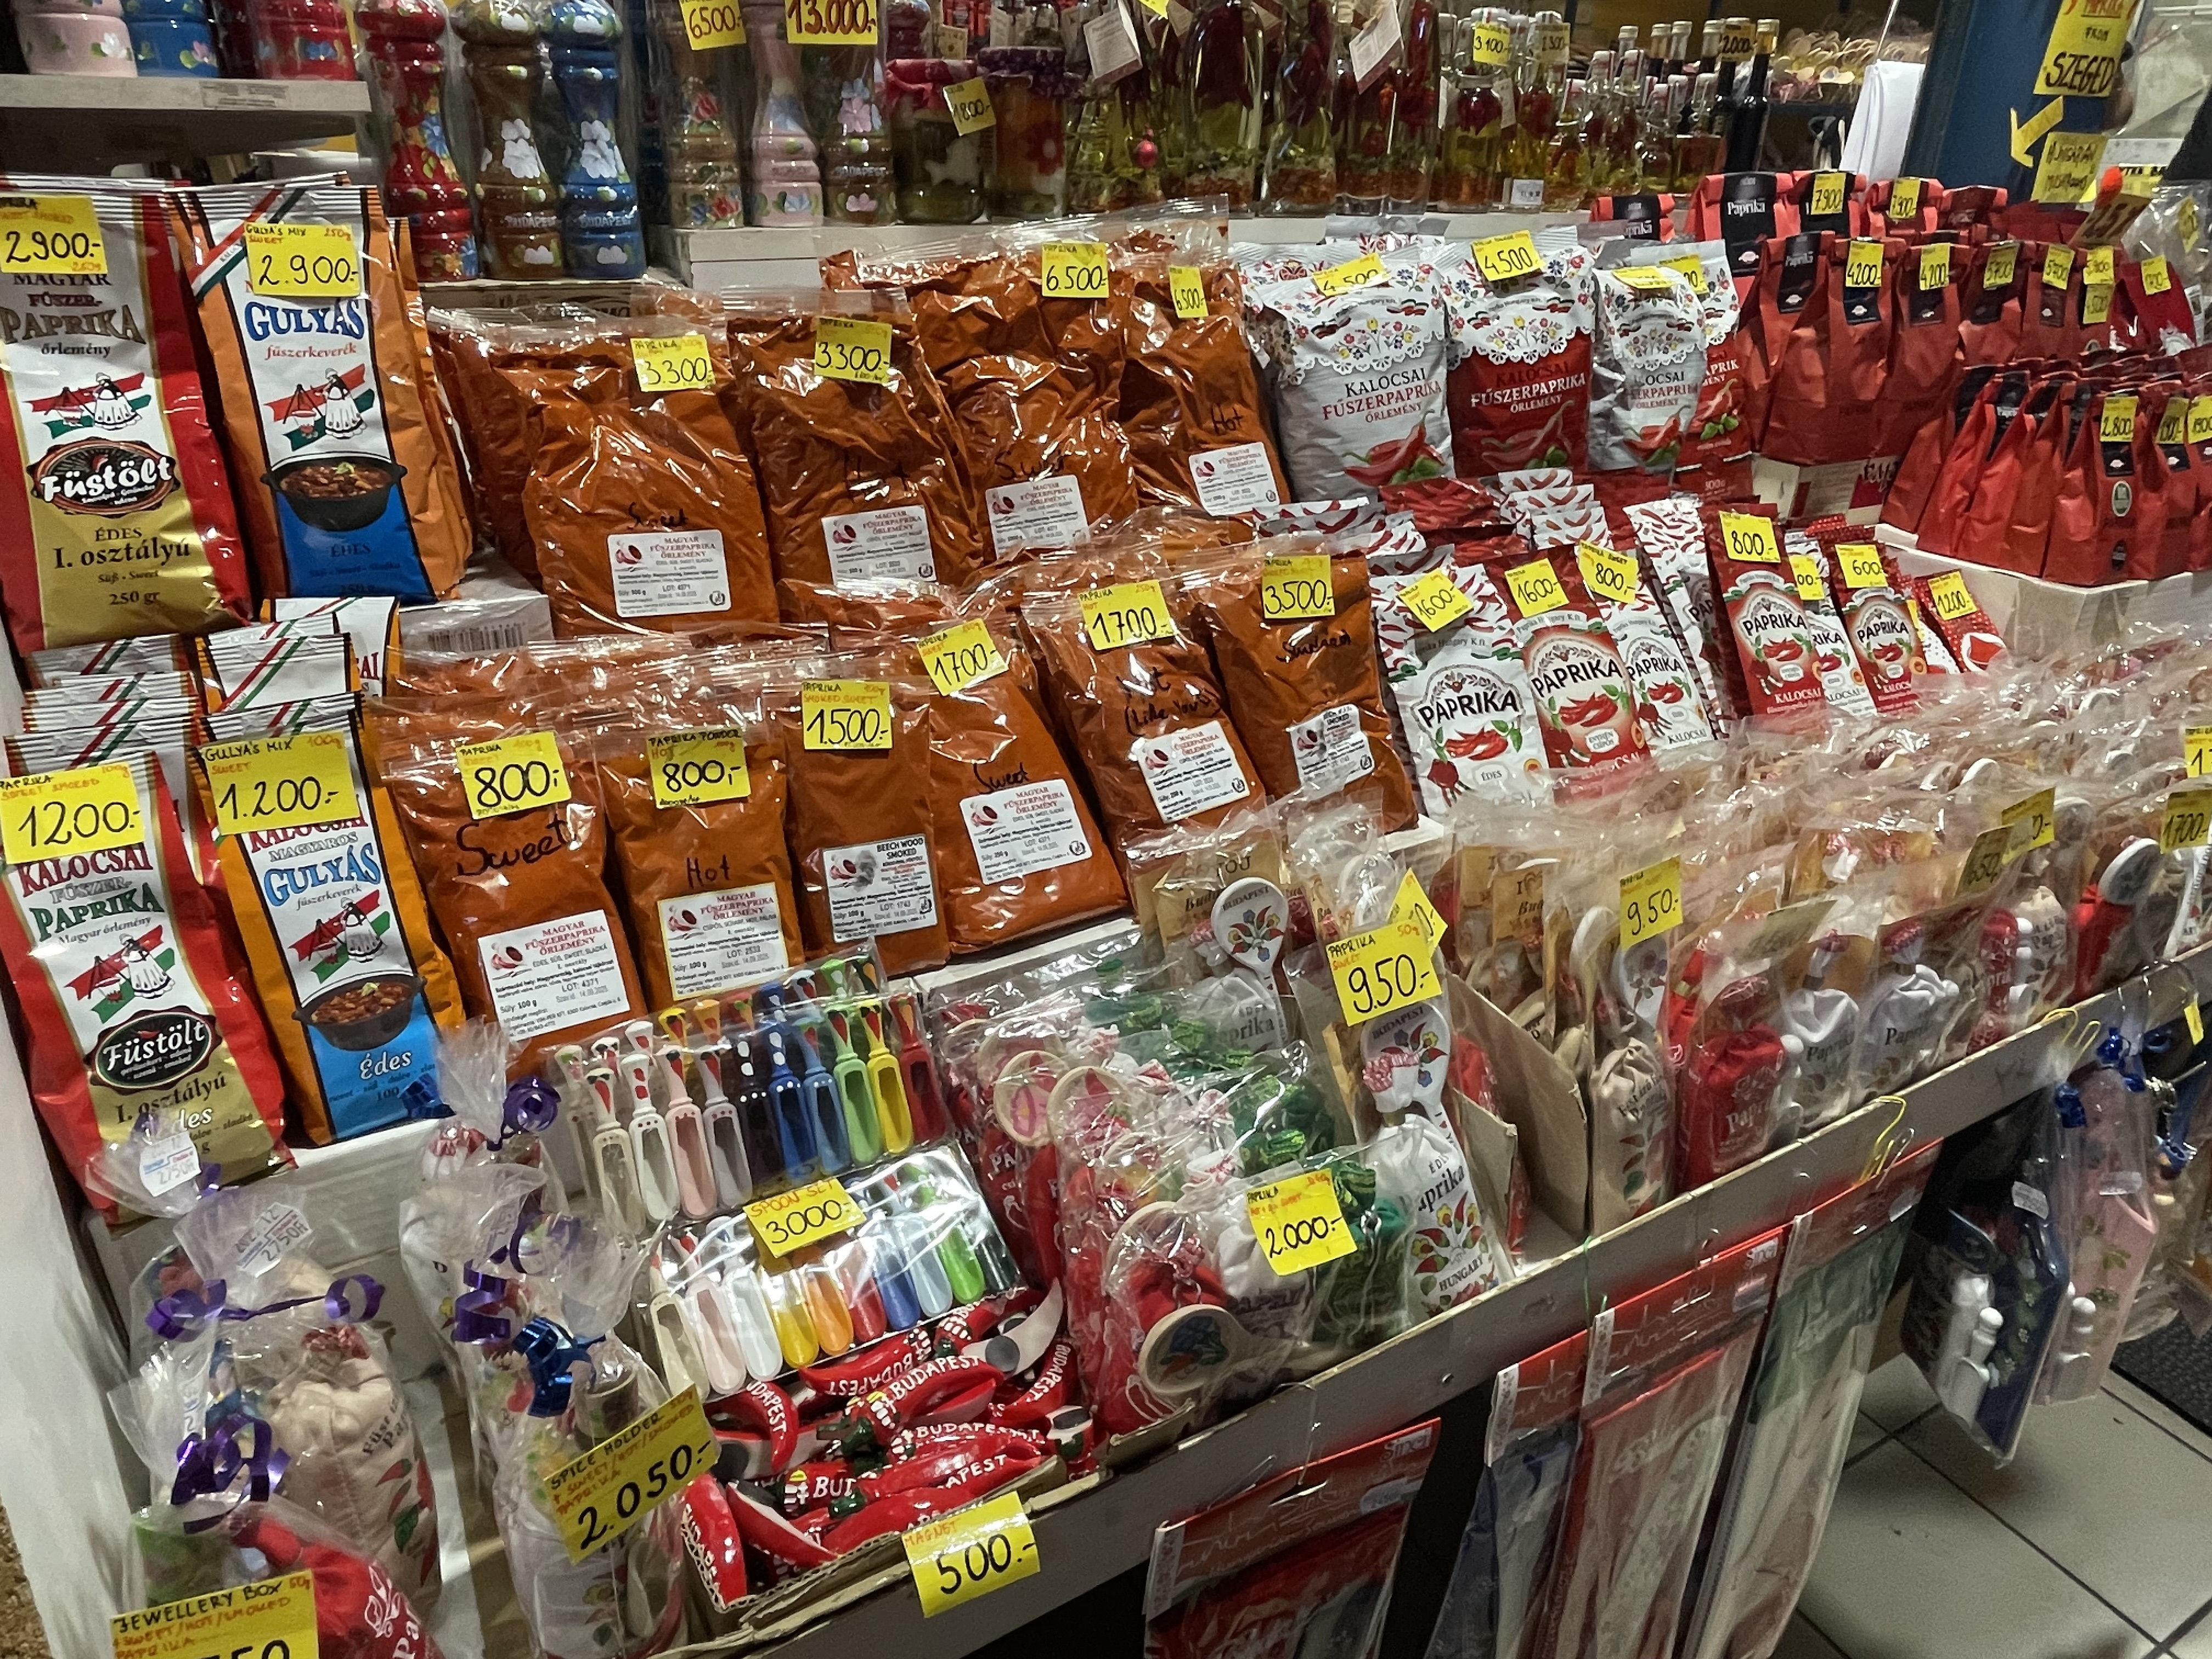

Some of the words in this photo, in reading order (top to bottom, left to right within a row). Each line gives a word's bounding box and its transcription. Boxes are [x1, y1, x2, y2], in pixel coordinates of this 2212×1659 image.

[2045, 51, 2115, 94] SZEGED
[1727, 200, 1767, 217] Paprika
[0, 304, 146, 345] PAPRIKA
[41, 342, 110, 357] őrlemény
[1345, 368, 1426, 397] KALOCSAI
[1496, 361, 1570, 388] KALOCSAI
[1322, 380, 1442, 420] FŰSZERPAPRIKA
[1471, 374, 1587, 408] FŰSZERPAPRIKA
[1510, 394, 1562, 414] ŐRLEMÉNY
[1211, 403, 1243, 436] Hot
[1364, 401, 1423, 423] ŐRLEMÉNY
[41, 456, 172, 502] Füstölt
[94, 527, 143, 542] ÉDES
[53, 548, 72, 569] I.
[81, 537, 191, 567] osztályú
[110, 591, 139, 605] 250
[144, 591, 160, 605] gr
[1079, 589, 1113, 602] PAPRIKA
[1742, 613, 1808, 636] PAPRIKA
[1857, 622, 1909, 643] PAPRIKA
[1532, 658, 1622, 697] PAPRIKA
[1626, 657, 1683, 680] PAPRIKA
[1418, 690, 1520, 728] PAPRIKA
[1774, 687, 1822, 704] KALOCSAI
[205, 741, 260, 761] GULYA'S
[267, 736, 295, 753] MIX
[1667, 729, 1708, 746] KALOCSAI
[974, 761, 1031, 794] Sweet
[1481, 770, 1503, 781] ÉDES
[1015, 787, 1049, 798] MAGYAR
[268, 831, 359, 862] MAGYAROS
[456, 815, 569, 876] Sweet
[877, 842, 900, 852] BEECH
[900, 837, 924, 848] WOOD
[887, 848, 917, 859] SMOKED
[17, 842, 154, 897] KALOCSAI
[263, 843, 382, 907] GULYÁS
[686, 854, 731, 889] Hot
[30, 882, 165, 942] PAPRIKA
[716, 891, 757, 902] MAGYAR
[1223, 885, 1270, 912] BUDAPEST
[103, 916, 151, 937] őrlemény
[542, 921, 585, 936] MAGYAR
[1328, 934, 1376, 958] PAPRIKA
[562, 982, 579, 992] LOT:
[518, 1000, 531, 1009] 100
[1372, 1006, 1425, 1040] BUDAPEST
[103, 1019, 205, 1071] Füstölt
[359, 1050, 413, 1081] Édes
[138, 1071, 227, 1113] osztályú
[751, 1192, 801, 1218] SPOON
[805, 1181, 833, 1201] SET
[1439, 1255, 1485, 1292] HUNGARY
[830, 1353, 913, 1396] BUDAPEST
[890, 1355, 980, 1400] BUDAPEST
[551, 1454, 596, 1490] SPICE
[603, 1412, 666, 1455] HOLDER
[945, 1453, 1007, 1489] APEST
[555, 1468, 622, 1516] PAPRIKA
[904, 1519, 961, 1546] MAGNET
[113, 1592, 232, 1634] JEWELLERY
[243, 1581, 283, 1601] BOX
